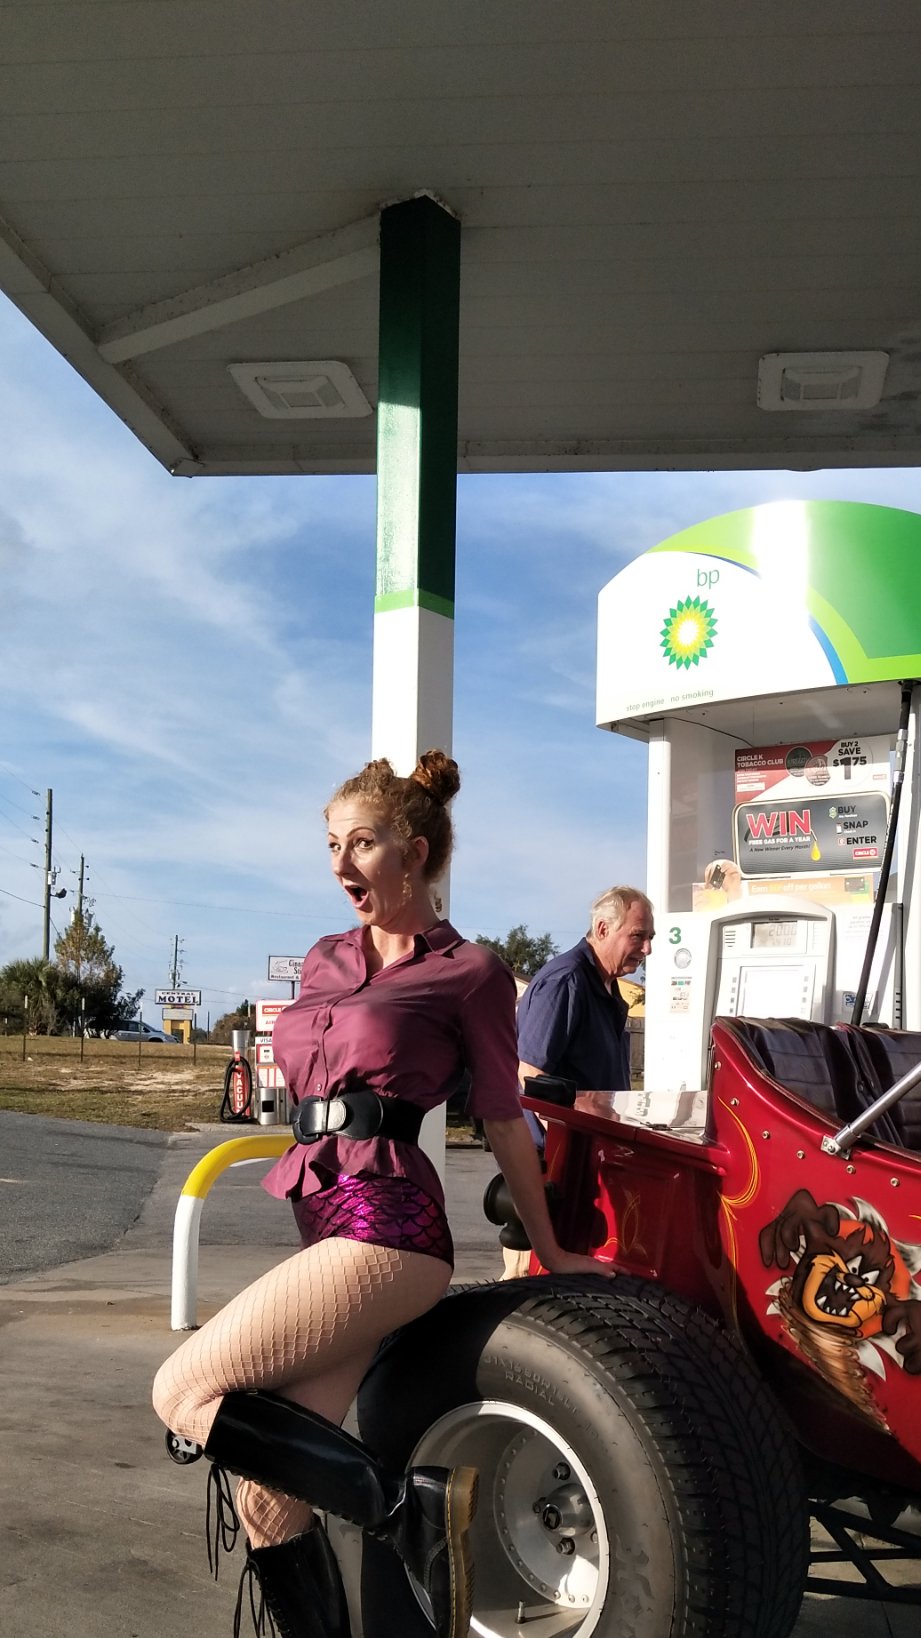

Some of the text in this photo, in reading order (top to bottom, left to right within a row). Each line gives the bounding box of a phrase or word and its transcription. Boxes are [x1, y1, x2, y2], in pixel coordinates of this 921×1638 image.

[696, 568, 720, 589] bp
[626, 688, 714, 712] stop engine no smoking
[838, 747, 861, 755] SAVE
[737, 758, 784, 768] TOBACCO CLUB
[837, 805, 856, 814] BUY
[746, 809, 811, 838] WIN
[843, 821, 869, 830] SNAP
[846, 836, 877, 845] ENTER
[751, 885, 768, 893] Earn
[668, 926, 682, 944] 3
[158, 995, 199, 1004] MOTEL
[505, 1370, 555, 1407] RADIAL
